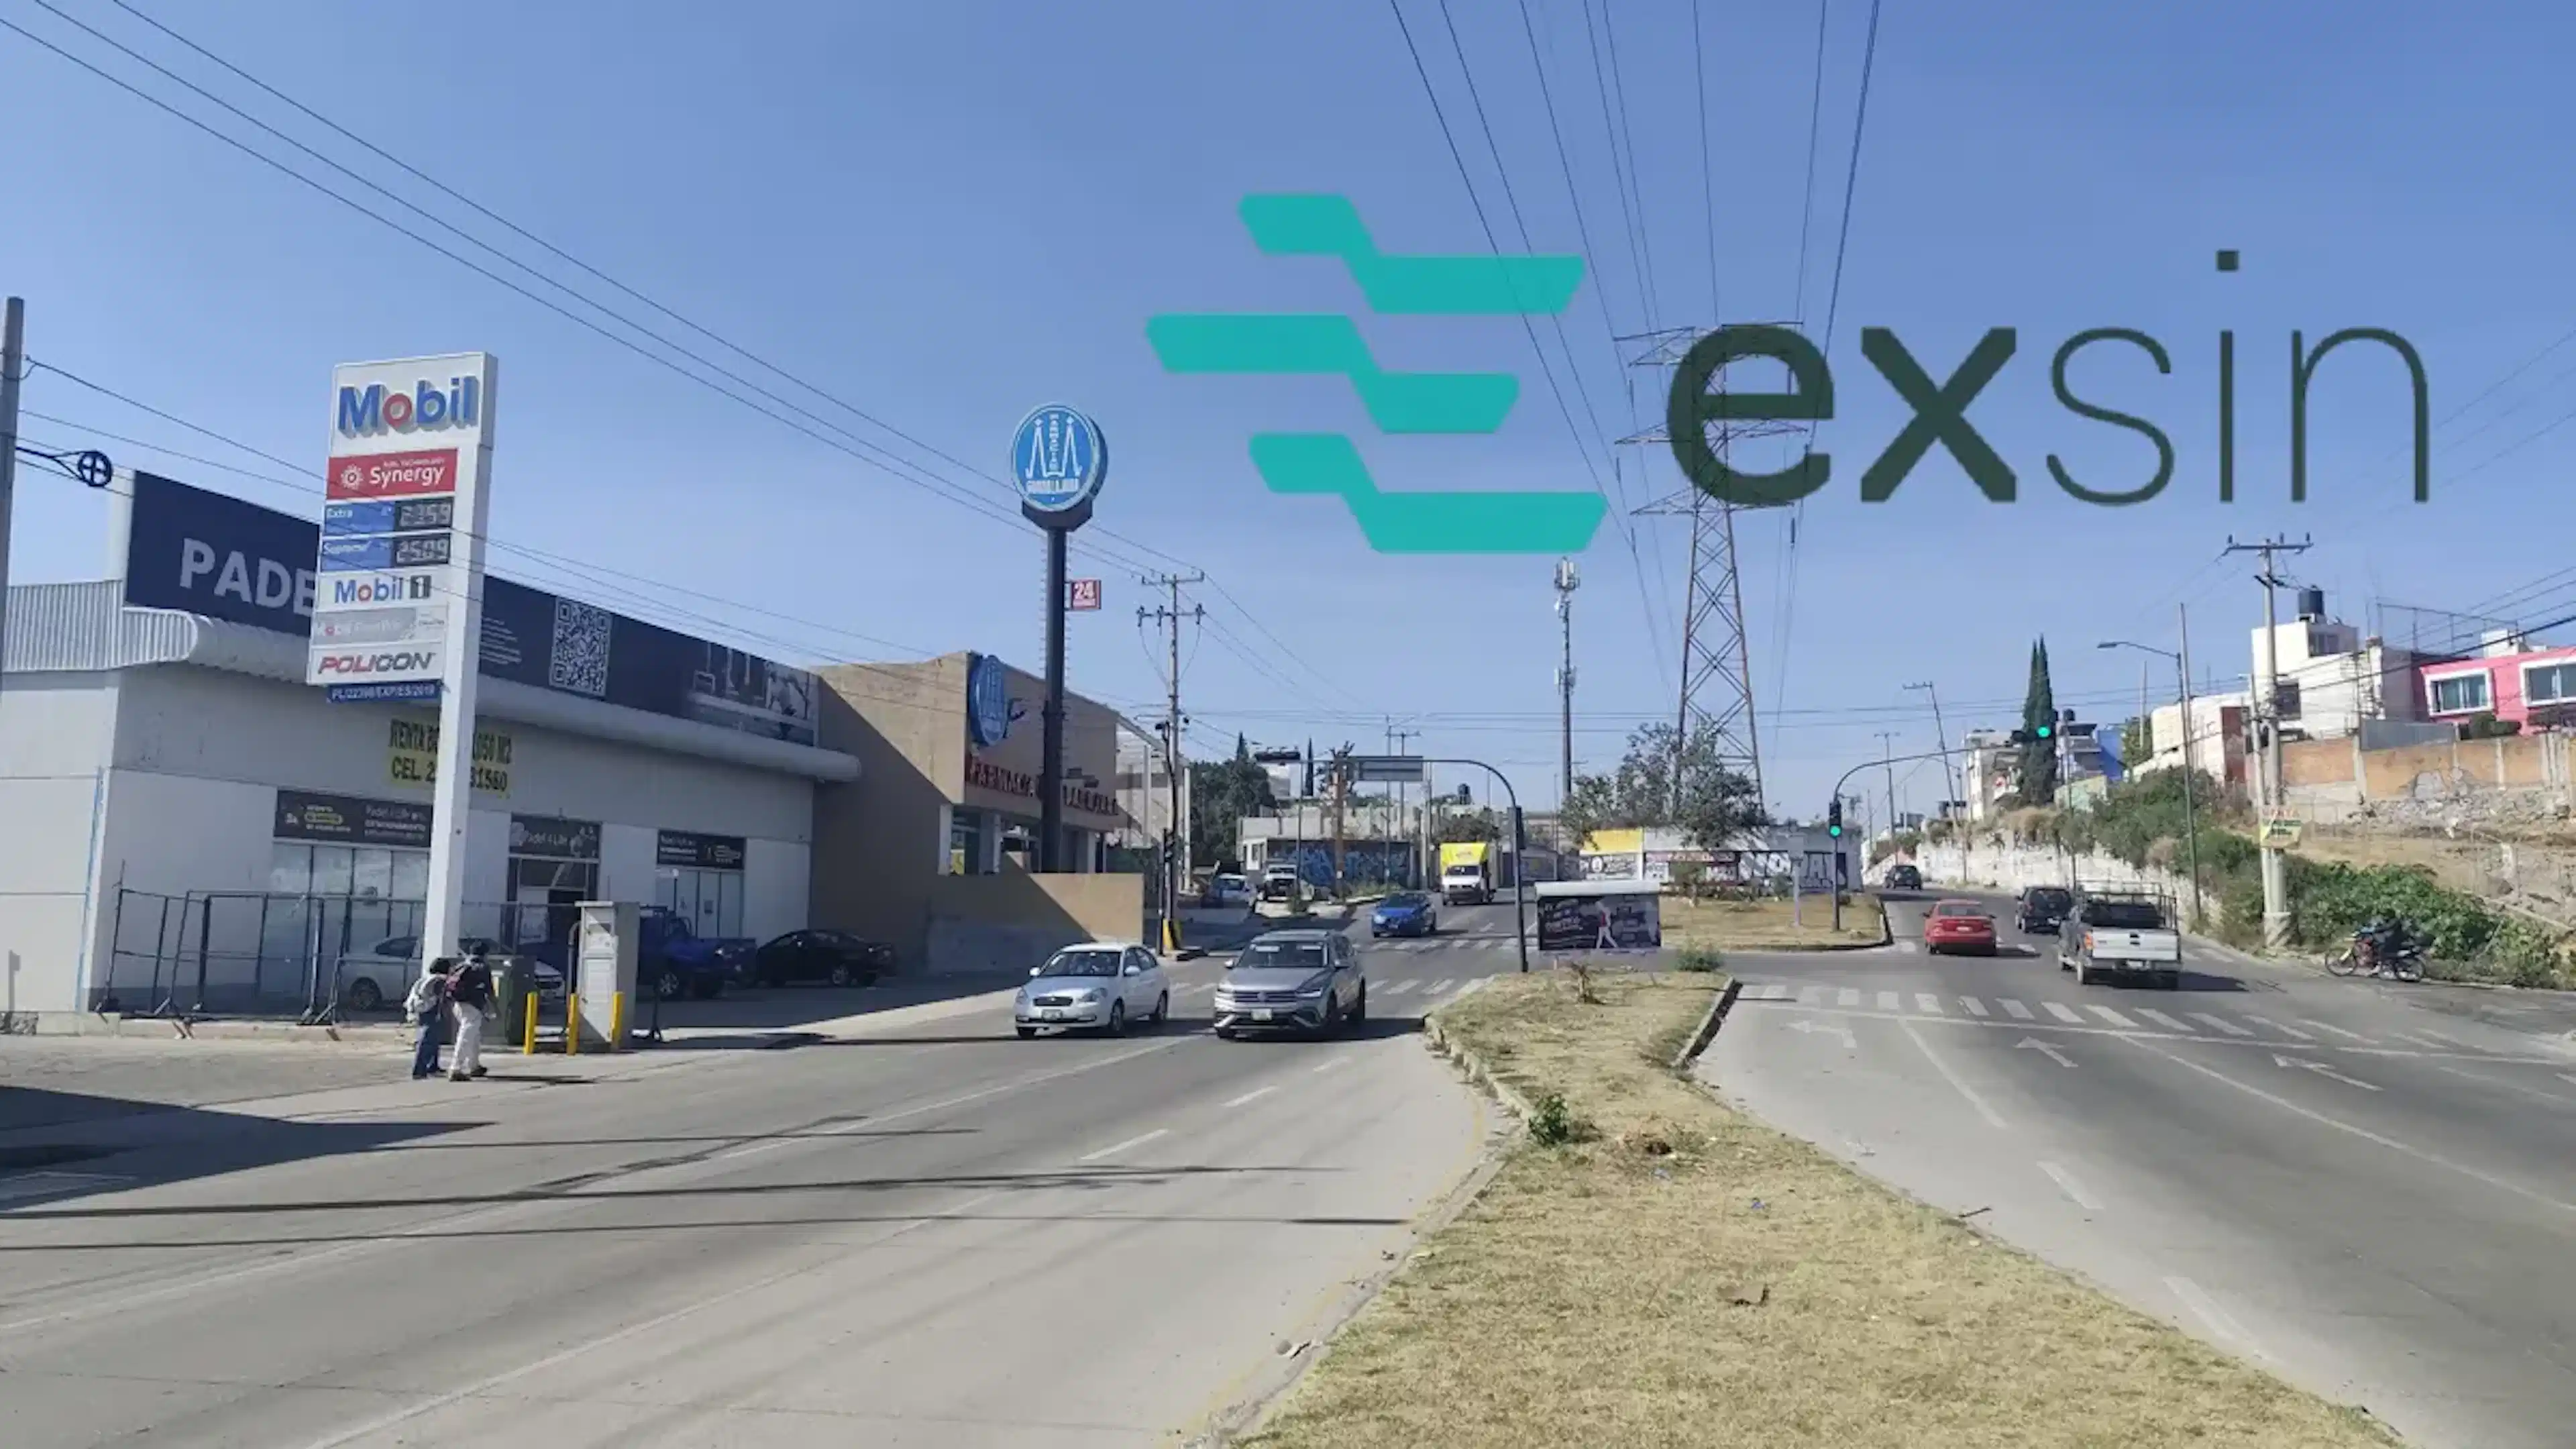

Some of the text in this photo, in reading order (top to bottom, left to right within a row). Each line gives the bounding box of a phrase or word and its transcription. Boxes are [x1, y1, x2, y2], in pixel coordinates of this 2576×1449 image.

[338, 376, 478, 437] Mobil
[370, 466, 446, 490] Synergy
[335, 578, 402, 604] Mobil
[1075, 582, 1093, 598] 24
[318, 651, 433, 674] POLICON
